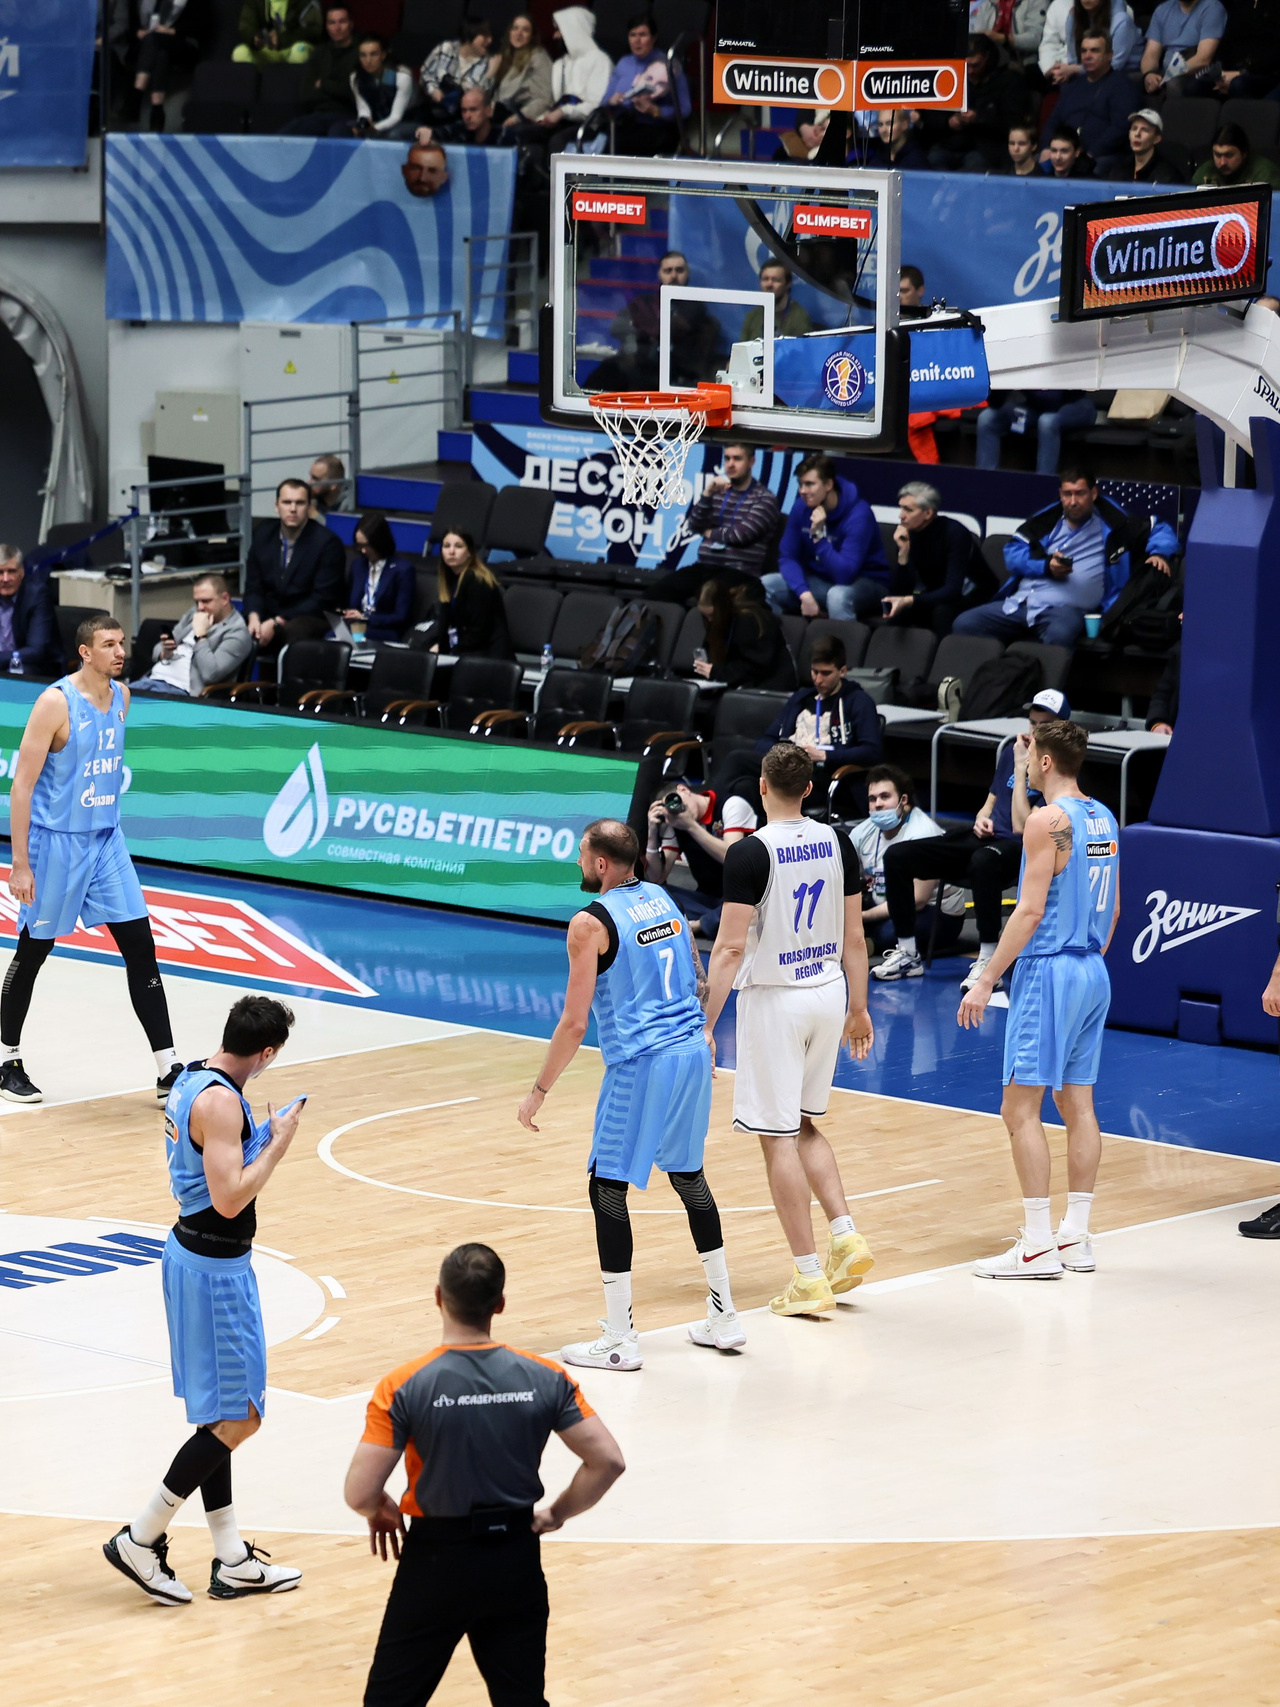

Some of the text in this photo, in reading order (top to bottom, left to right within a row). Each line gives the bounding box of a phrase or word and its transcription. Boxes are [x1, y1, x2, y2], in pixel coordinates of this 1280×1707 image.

[733, 69, 809, 94] Winline
[871, 75, 930, 95] Winline
[575, 199, 643, 217] OLIMPBET
[796, 213, 867, 231] OLIMPBET
[1106, 236, 1205, 275] Winline
[1253, 375, 1280, 415] SPAL
[548, 502, 663, 547] ЕЗОН
[98, 728, 116, 751] 12
[333, 798, 575, 859] РУСВЬЕТПЕТРО
[327, 844, 466, 875] совместная компания
[776, 841, 833, 864] BALASHOV
[626, 896, 671, 924] KARASEV
[793, 879, 825, 934] 11
[640, 926, 672, 943] Winline
[659, 947, 674, 1000] 7
